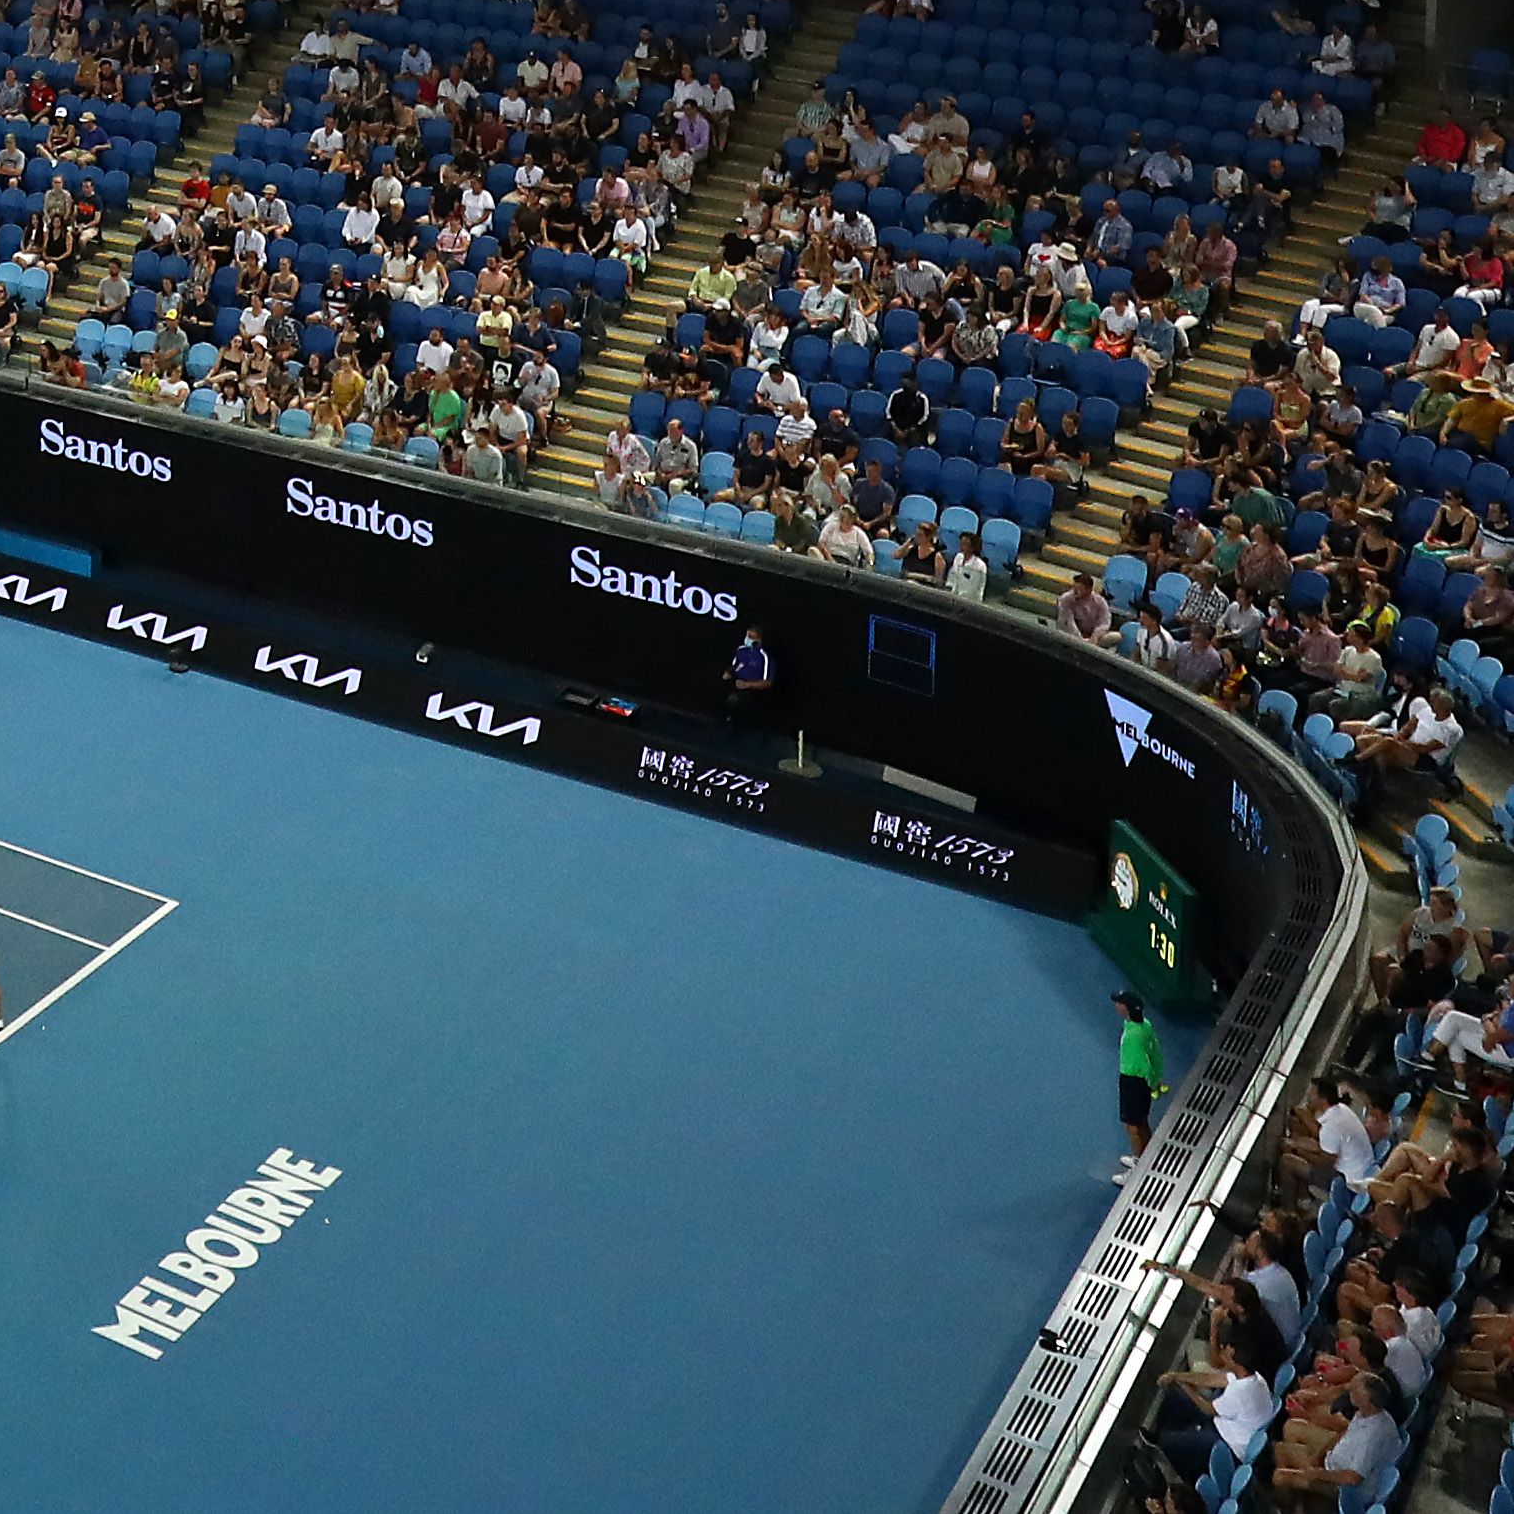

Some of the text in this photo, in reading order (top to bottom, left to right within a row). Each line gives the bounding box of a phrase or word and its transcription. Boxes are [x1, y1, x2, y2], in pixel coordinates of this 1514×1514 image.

[40, 417, 172, 482] Santos
[286, 477, 434, 547] Santos
[570, 543, 738, 622] Santos
[106, 604, 208, 652] KIA
[254, 645, 362, 695] KIA
[425, 692, 541, 745] KIA
[967, 862, 1010, 882] 1573
[1148, 890, 1178, 929] ROLEX
[1149, 922, 1176, 969] 1:30
[90, 1146, 343, 1361] MELBOURNE
